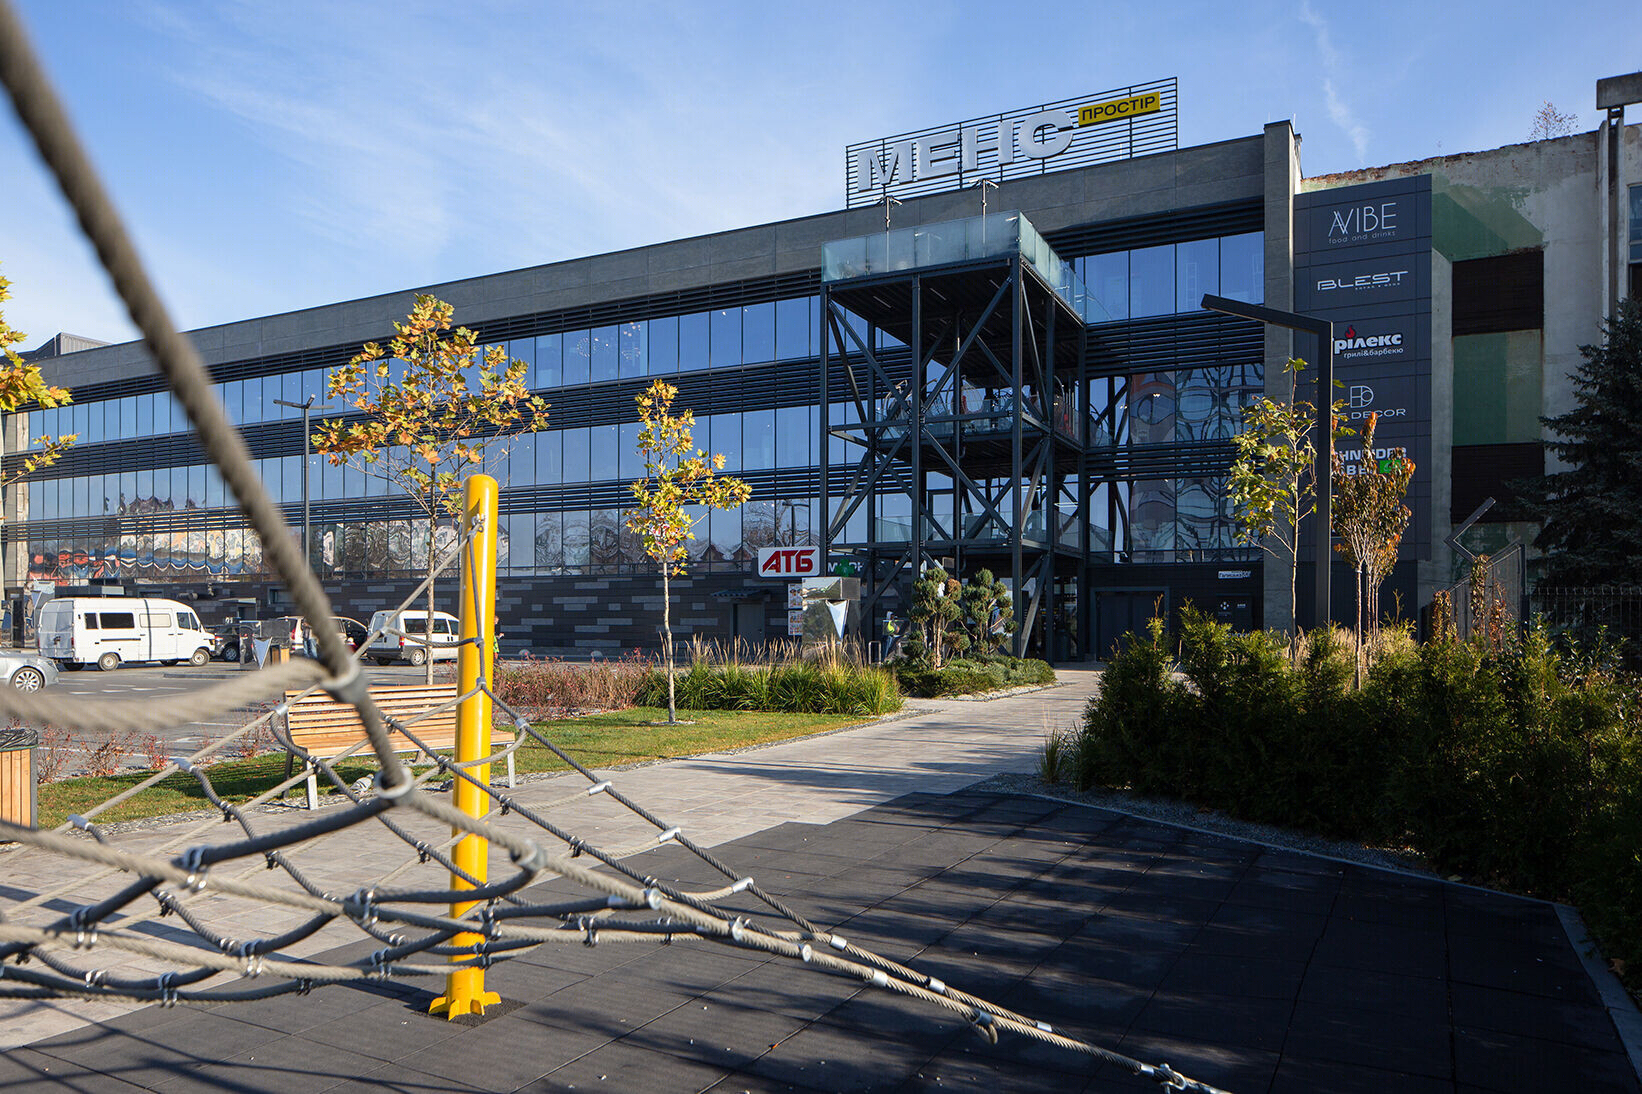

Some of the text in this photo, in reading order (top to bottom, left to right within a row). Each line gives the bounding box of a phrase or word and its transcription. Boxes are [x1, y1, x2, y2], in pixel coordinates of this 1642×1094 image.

[1081, 95, 1156, 122] ПРОСТІР
[857, 109, 1074, 192] МЕНС
[1328, 230, 1396, 244] food and drinks
[1317, 270, 1409, 291] BLEST
[1331, 334, 1403, 355] рілекс
[1351, 408, 1406, 420] DECOR
[762, 549, 816, 573] АТБ
